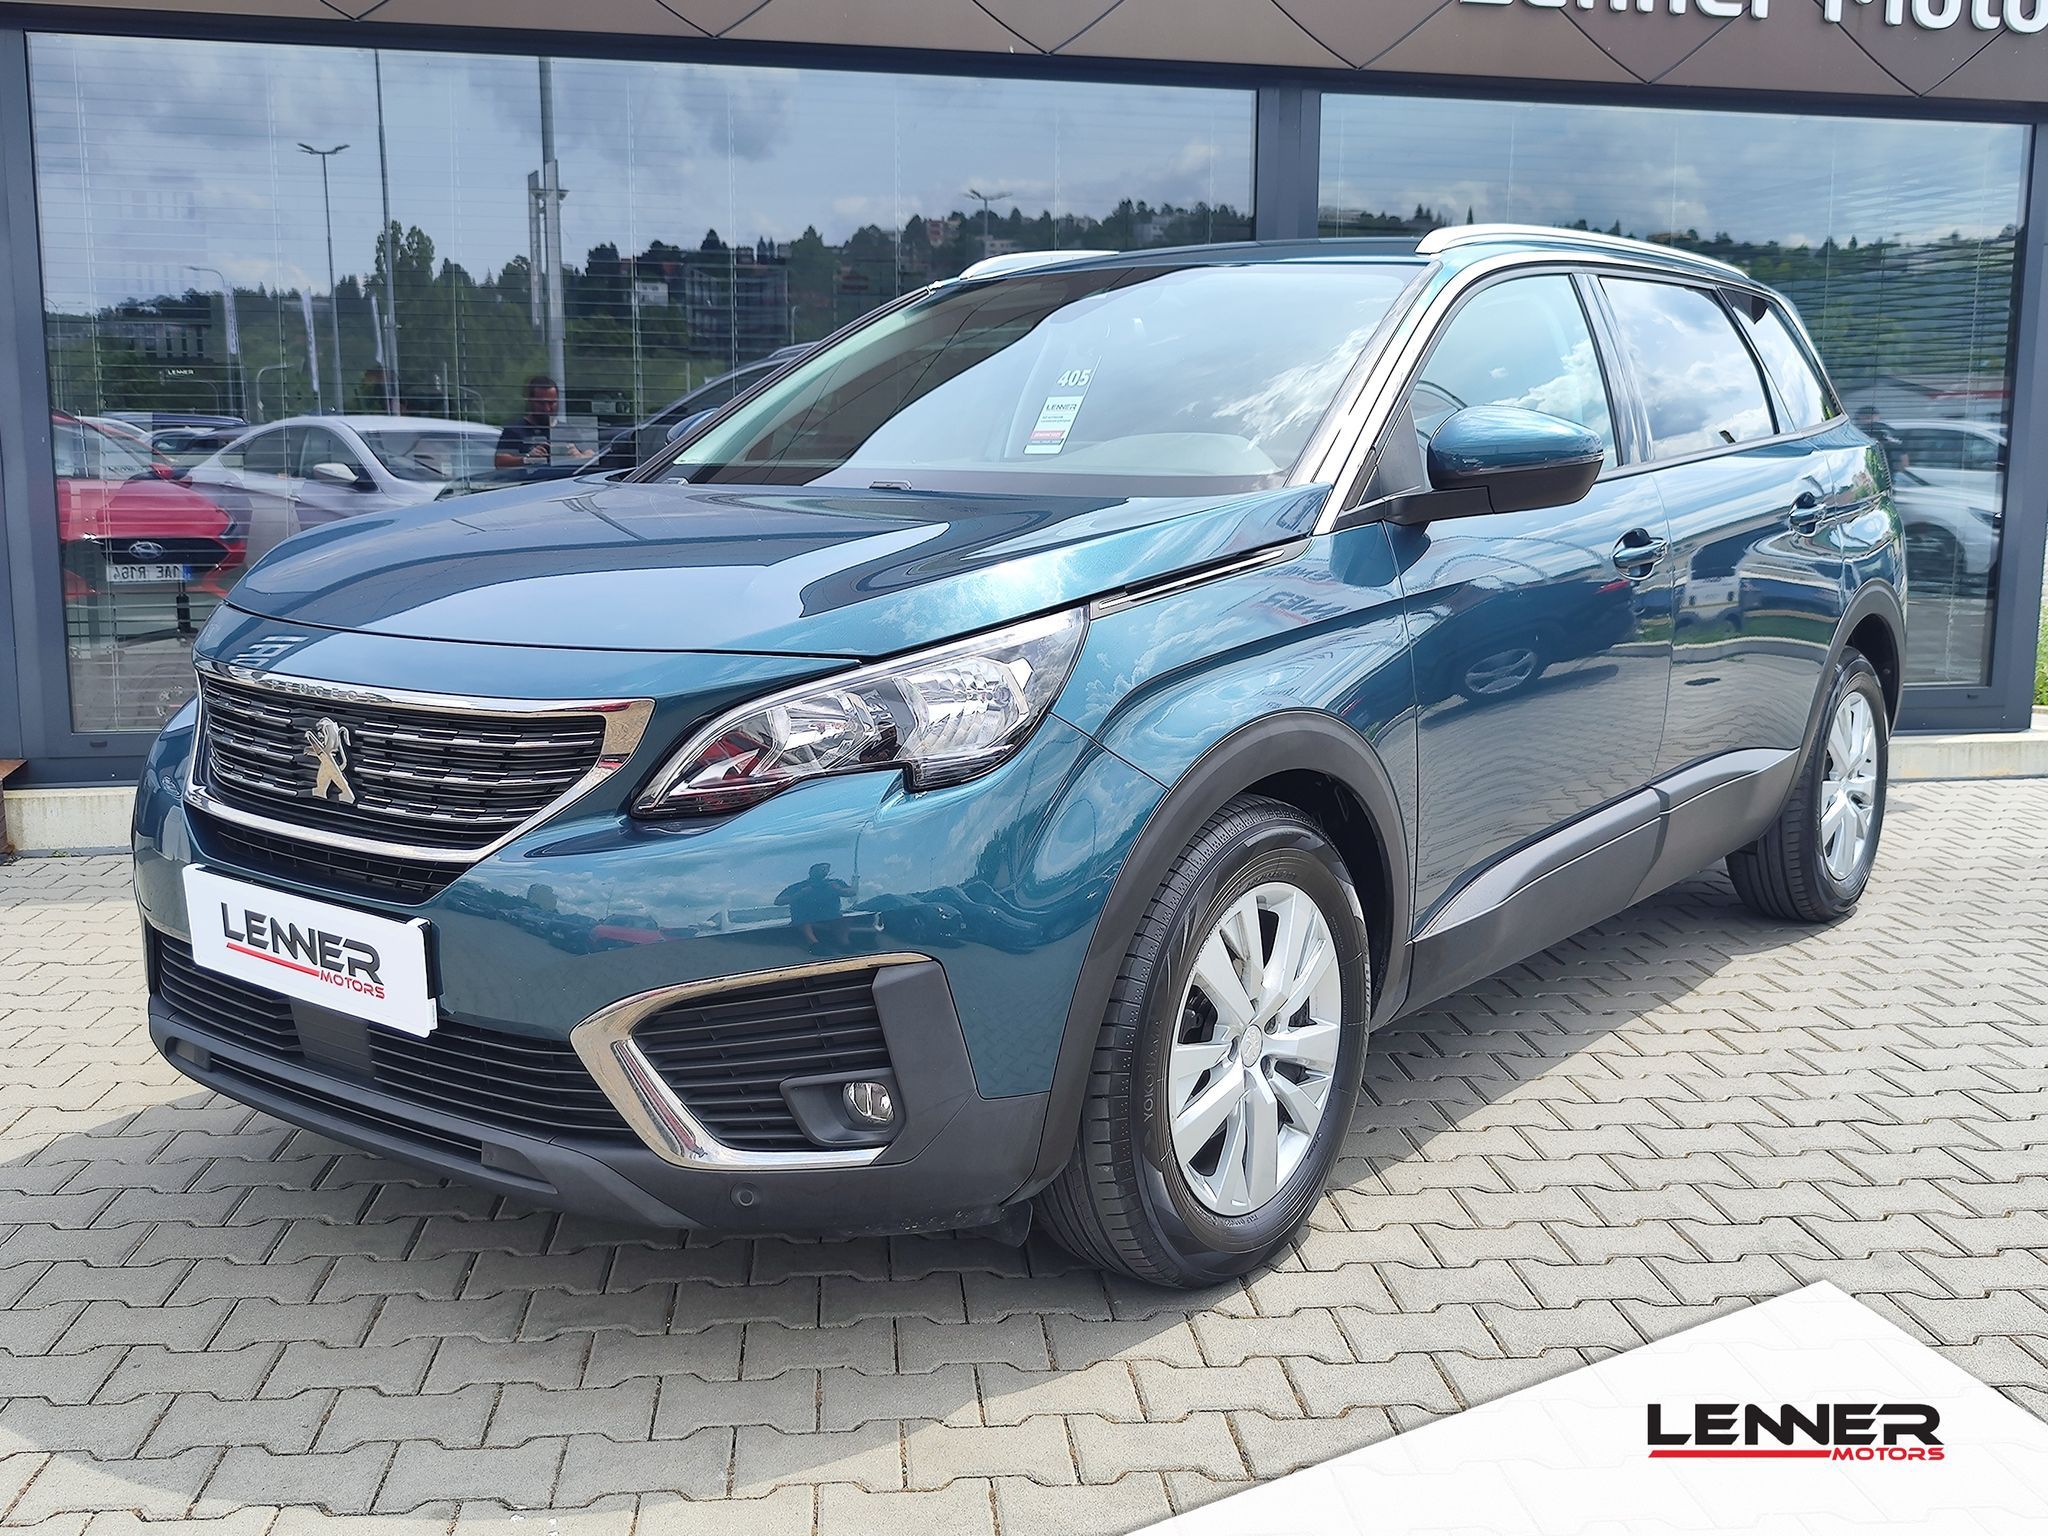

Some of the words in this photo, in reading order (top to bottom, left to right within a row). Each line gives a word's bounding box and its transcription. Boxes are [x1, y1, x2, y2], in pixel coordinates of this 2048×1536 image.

[1057, 369, 1091, 387] 405
[220, 901, 385, 986] LENNER
[319, 971, 385, 1000] MOTORS
